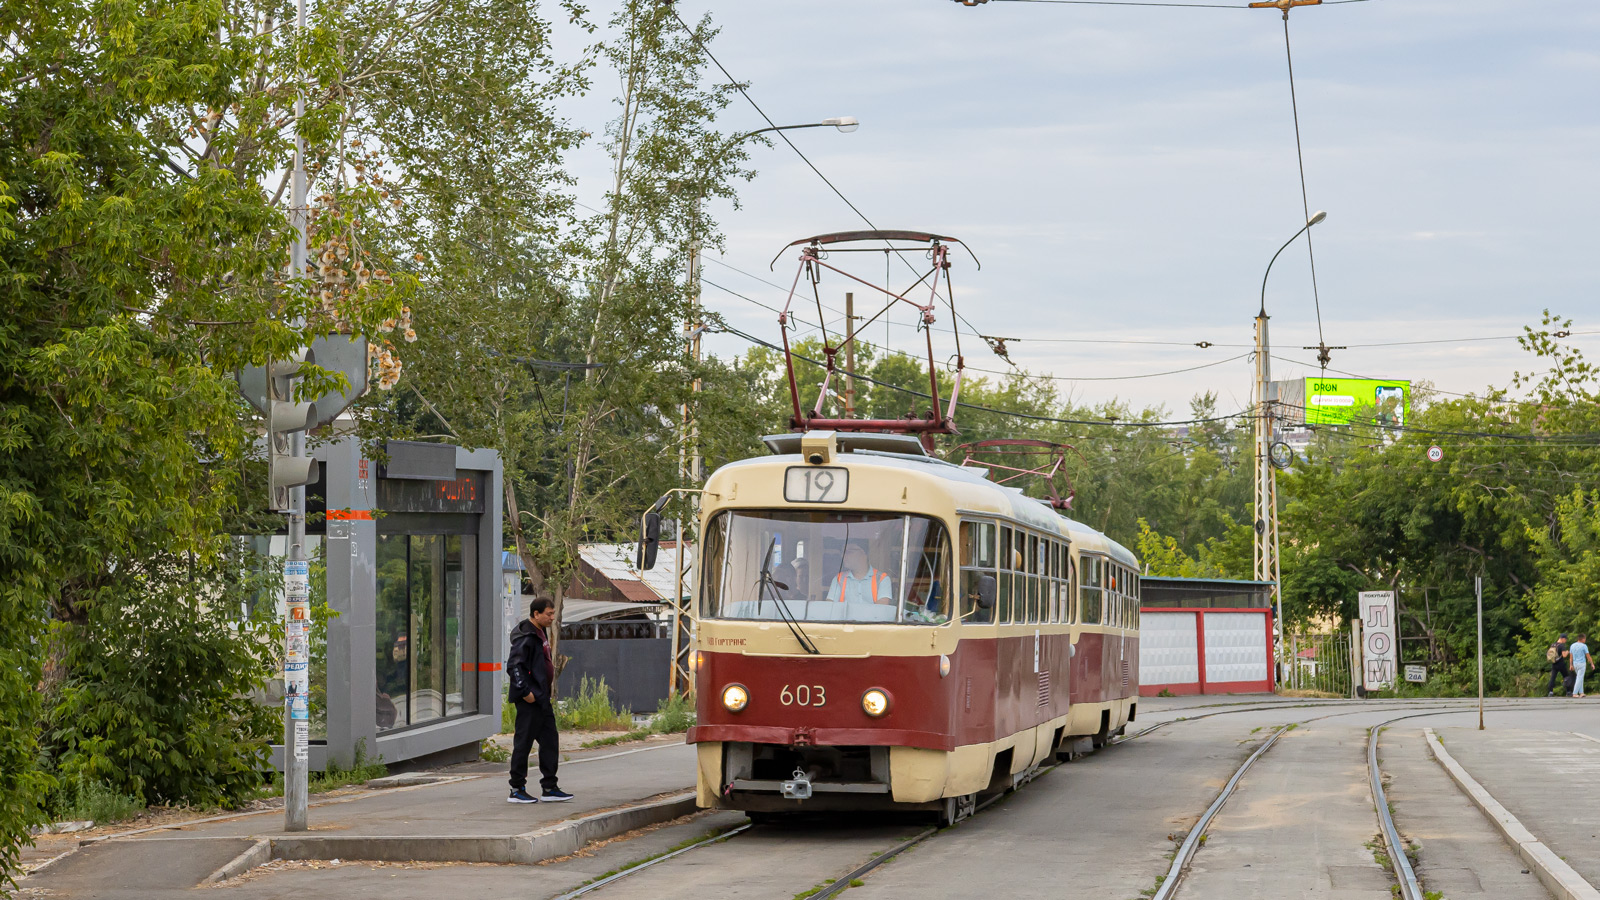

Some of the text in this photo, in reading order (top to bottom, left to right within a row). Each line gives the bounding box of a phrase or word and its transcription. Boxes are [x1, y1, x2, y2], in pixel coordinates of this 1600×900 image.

[1314, 383, 1338, 392] DRON
[804, 471, 834, 501] 19
[297, 608, 303, 618] 7
[1367, 605, 1391, 682] ЛОМ
[780, 684, 826, 708] 603
